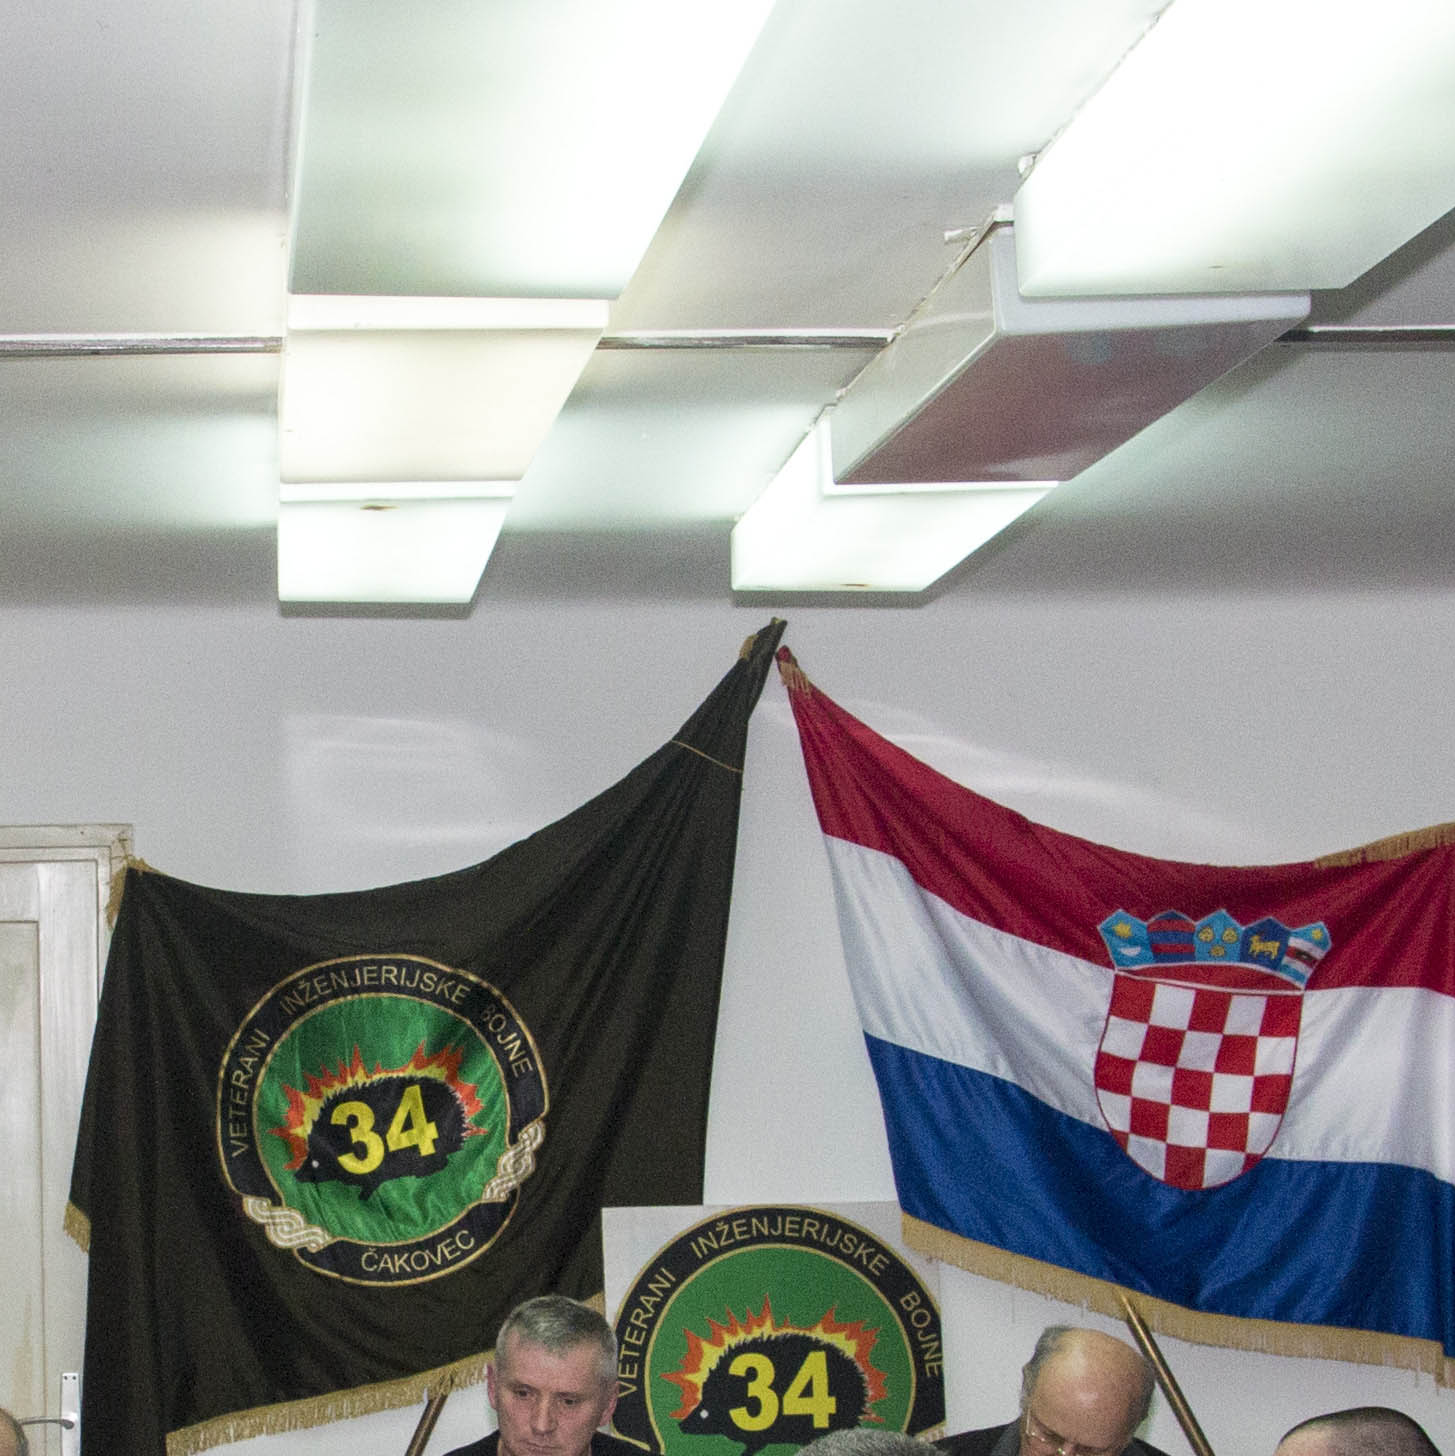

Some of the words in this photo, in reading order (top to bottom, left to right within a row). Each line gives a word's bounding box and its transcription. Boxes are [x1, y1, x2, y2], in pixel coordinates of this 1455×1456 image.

[231, 1028, 271, 1158] VETERANI
[279, 965, 470, 1015] INŽENJERIJSKE
[481, 1003, 534, 1078] BOJNE
[330, 1083, 439, 1175] 34
[360, 1228, 476, 1273] ČAKOVEC
[616, 1267, 676, 1398] VETERANI
[690, 1216, 890, 1277] INŽENJERIJSKE
[900, 1290, 944, 1377] BOJNE
[728, 1350, 837, 1432] 34
